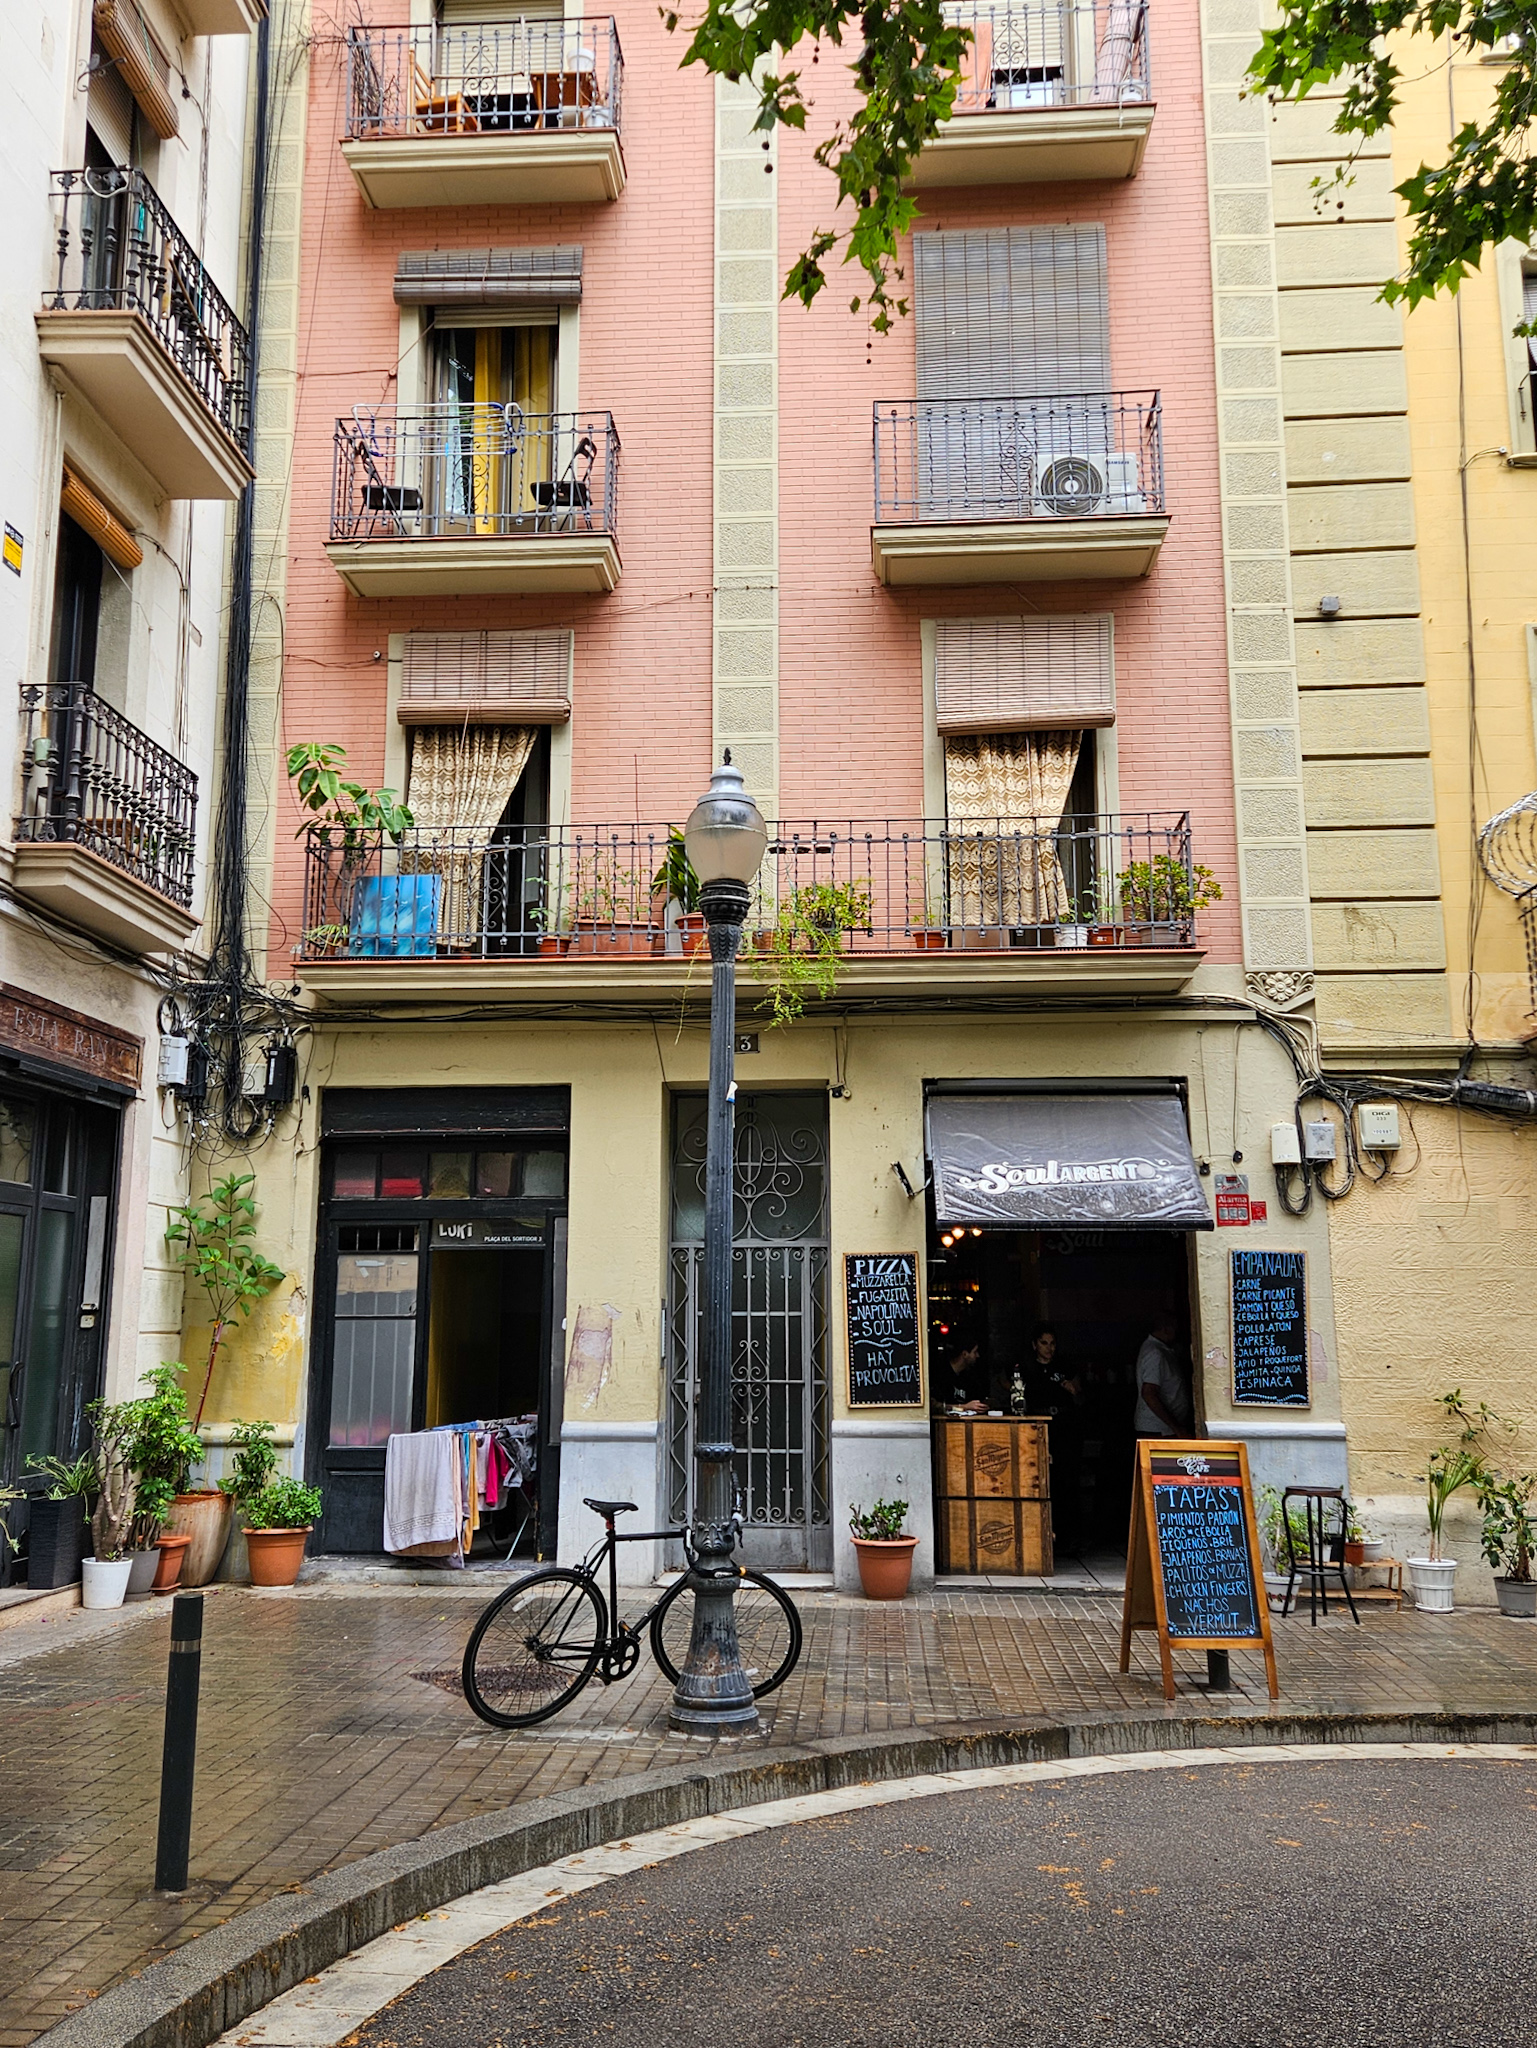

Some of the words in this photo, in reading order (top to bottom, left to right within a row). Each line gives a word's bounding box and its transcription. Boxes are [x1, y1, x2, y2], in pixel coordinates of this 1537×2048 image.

[740, 1035, 752, 1051] 3
[970, 1160, 1061, 1195] Soul
[855, 1258, 912, 1275] PIZZA
[1234, 1251, 1304, 1279] EMPANADAS
[856, 1273, 911, 1288] MUZZARELLA
[1236, 1278, 1262, 1290] CARNE
[859, 1287, 910, 1303] FUGAZETTA
[1236, 1290, 1262, 1301] CARNE
[1263, 1287, 1295, 1300] PICANTE
[857, 1302, 913, 1320] NAPOLITANA
[1270, 1299, 1295, 1312] QUESO
[1236, 1312, 1269, 1321] CEBOLLA
[1275, 1310, 1299, 1320] QUESO
[862, 1320, 902, 1337] SOUL
[1238, 1323, 1264, 1333] POLLO
[1237, 1334, 1275, 1346] CAPRESE
[867, 1349, 894, 1367] HAY
[1238, 1358, 1256, 1368] APIO
[1264, 1354, 1303, 1364] ROQUEFORT
[1238, 1367, 1269, 1378] HUMITA
[1273, 1364, 1302, 1375] QUINOA
[1240, 1376, 1293, 1389] ESPINACA
[1164, 1487, 1229, 1510] TAPAS
[1160, 1511, 1205, 1526] PIMIENTOS
[1162, 1526, 1187, 1540] AROS
[1194, 1525, 1231, 1537] CEBOLLA
[1212, 1535, 1235, 1548] BRIE
[1215, 1547, 1246, 1562] BRAVAS
[1167, 1565, 1209, 1583] PALITOS
[1216, 1563, 1247, 1580] MUZZA
[1169, 1582, 1209, 1598] CHICKEN
[1209, 1580, 1247, 1596] FINGERS
[1184, 1597, 1229, 1613] NACHOS
[1187, 1612, 1239, 1631] VERMUT
